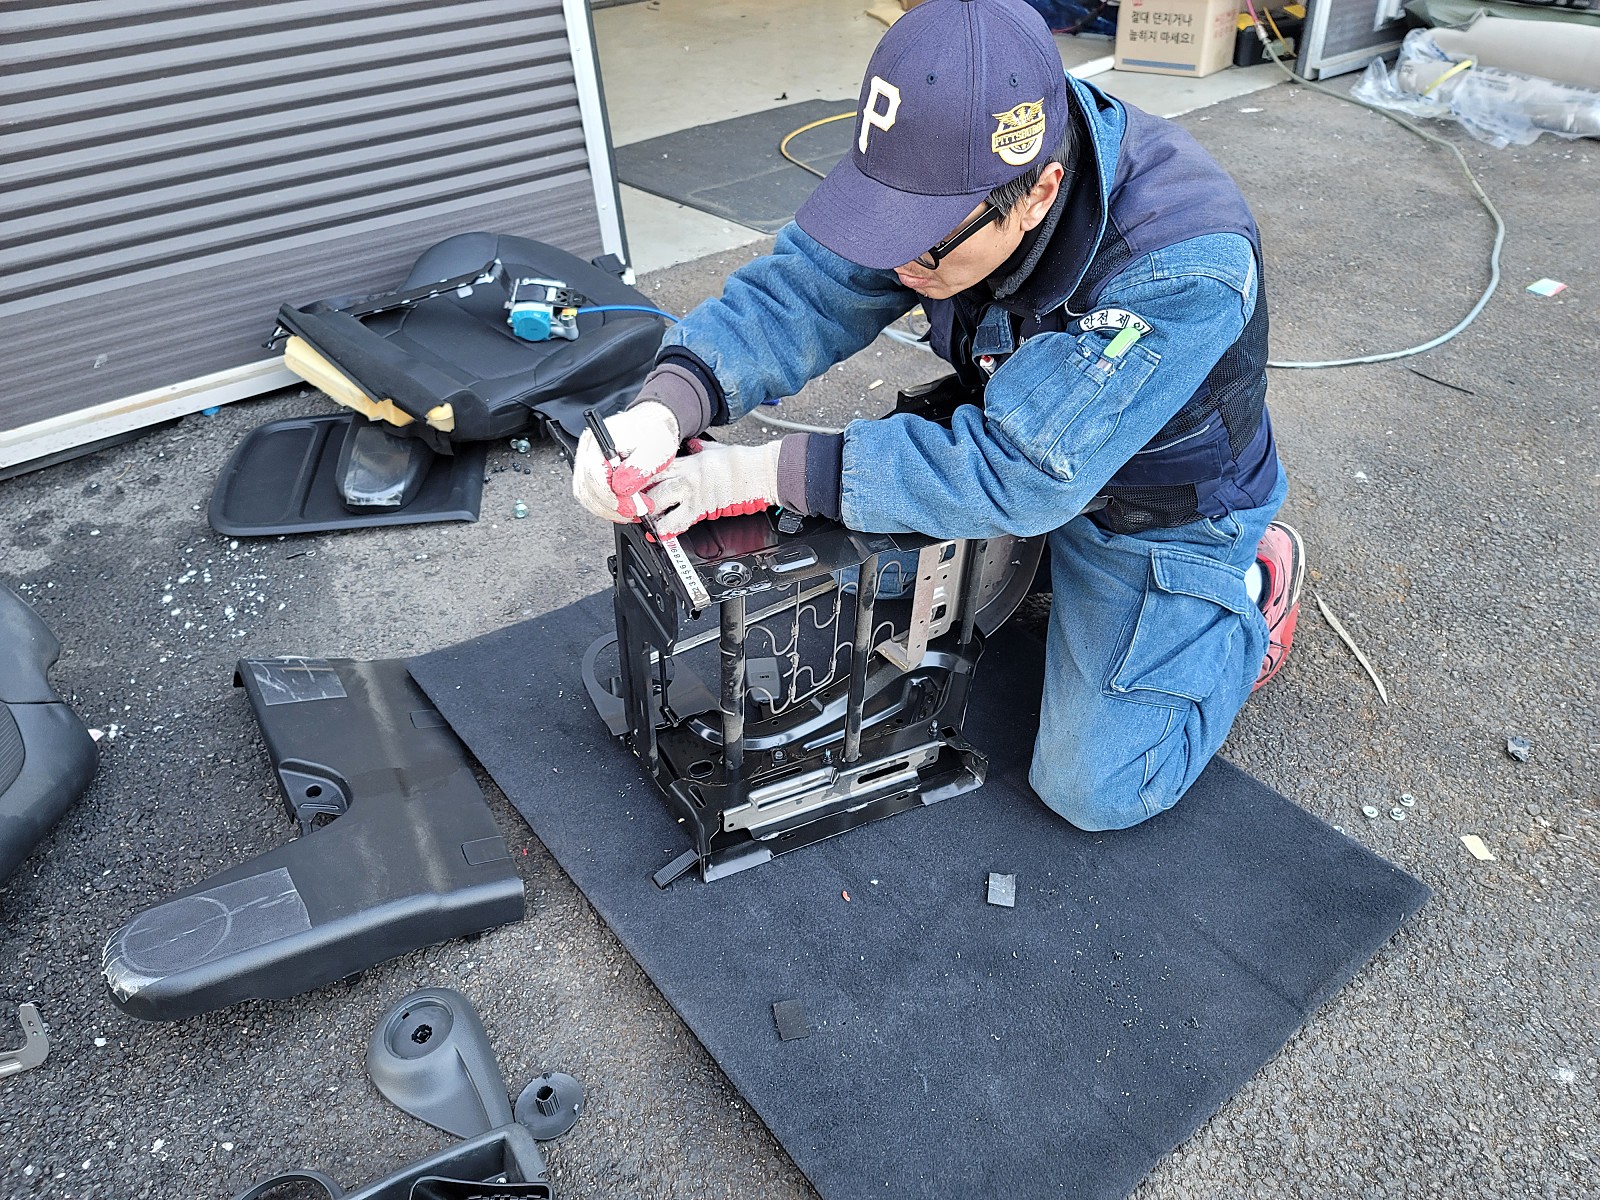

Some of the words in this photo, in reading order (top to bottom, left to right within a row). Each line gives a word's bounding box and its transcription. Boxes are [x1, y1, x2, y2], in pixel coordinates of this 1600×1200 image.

[1131, 11, 1149, 24] 절대
[1152, 12, 1192, 27] 던지거나
[1160, 31, 1195, 45] 마세요!
[858, 75, 902, 155] P
[995, 121, 1043, 147] PITTSBU
[1083, 311, 1109, 330] 안전
